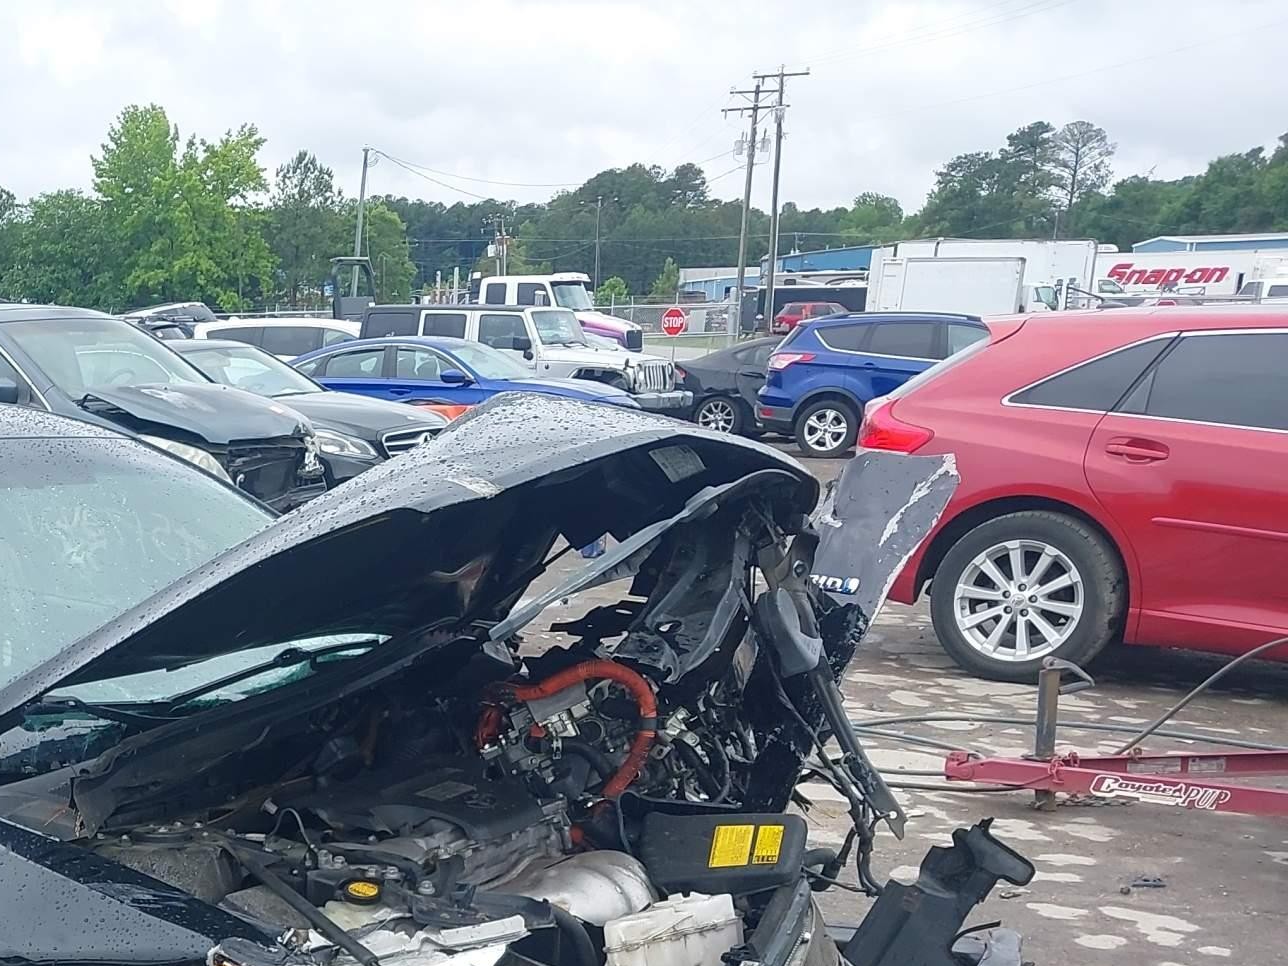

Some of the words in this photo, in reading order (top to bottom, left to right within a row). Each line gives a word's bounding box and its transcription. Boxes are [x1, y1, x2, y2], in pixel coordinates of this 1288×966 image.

[1107, 263, 1230, 290] Snap-on
[663, 316, 684, 328] STOP
[1090, 774, 1173, 798] Coyote
[1179, 787, 1231, 810] PUP
